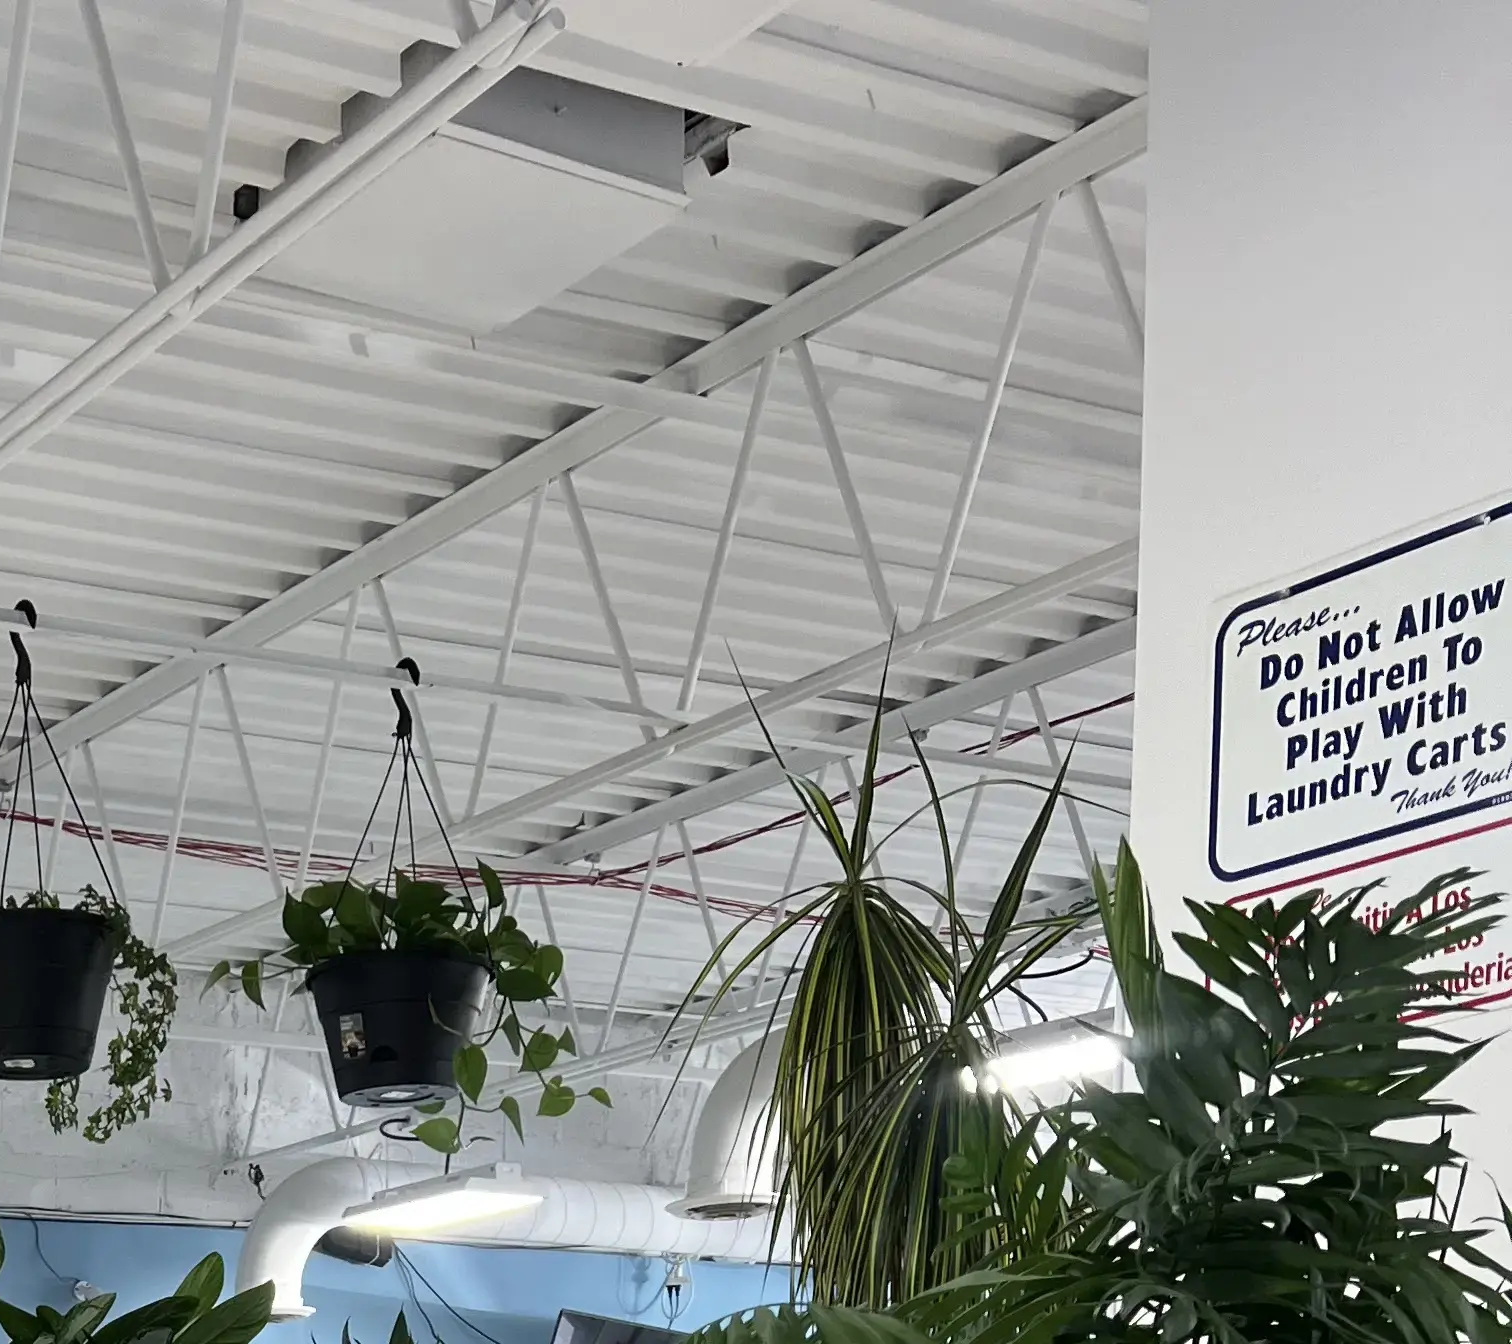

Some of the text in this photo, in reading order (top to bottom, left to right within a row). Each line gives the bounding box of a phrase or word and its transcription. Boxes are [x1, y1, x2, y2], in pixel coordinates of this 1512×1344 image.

[1236, 605, 1361, 658] Please...
[1260, 578, 1506, 691] Do Not Allow
[1276, 632, 1483, 728] Children To
[1286, 682, 1468, 771] Play With
[1247, 722, 1507, 827] Laundry Carts
[1391, 774, 1458, 813] Thank
